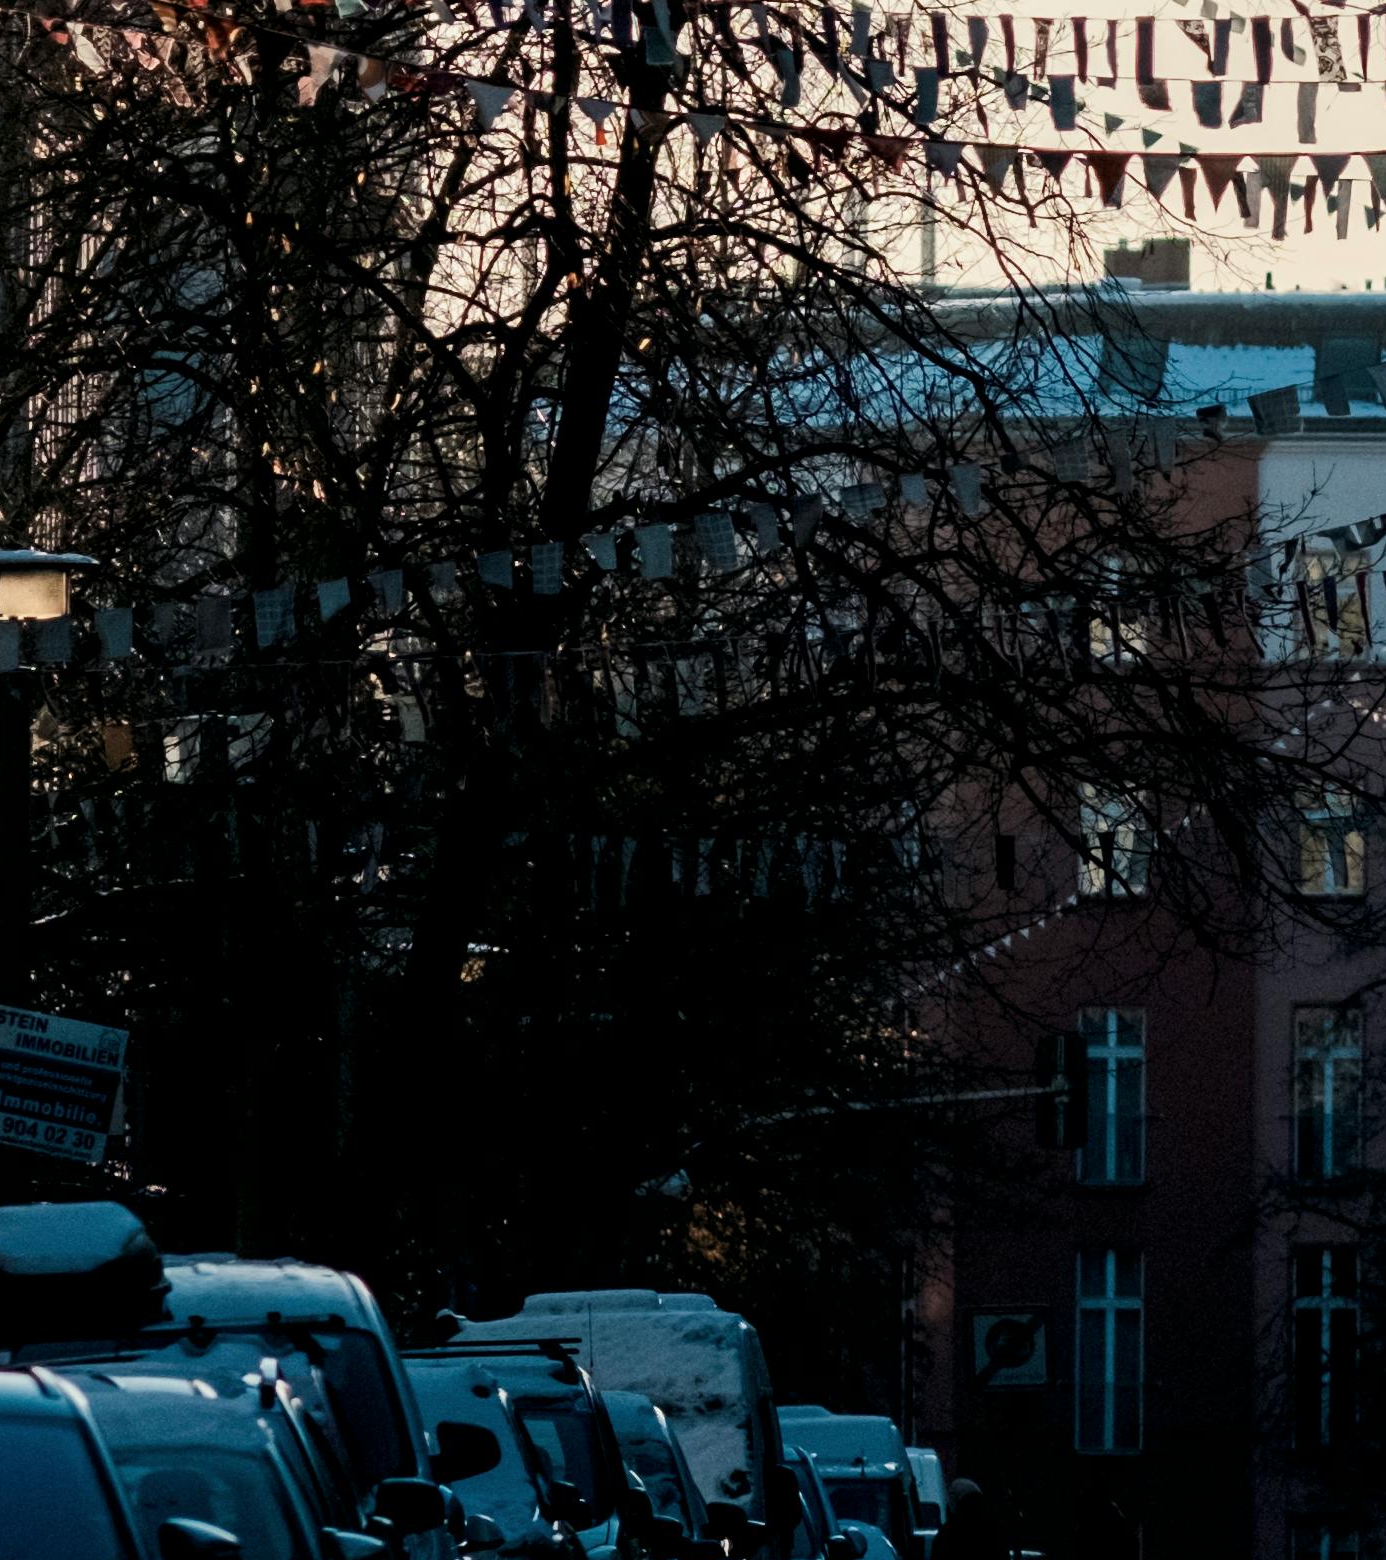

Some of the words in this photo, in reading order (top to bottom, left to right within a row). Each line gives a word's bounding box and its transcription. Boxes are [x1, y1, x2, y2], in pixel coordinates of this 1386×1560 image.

[15, 1033, 120, 1066] IMMOBILIEN
[3, 1117, 38, 1138] 904
[44, 1125, 67, 1144] 02
[72, 1132, 95, 1150] 30
